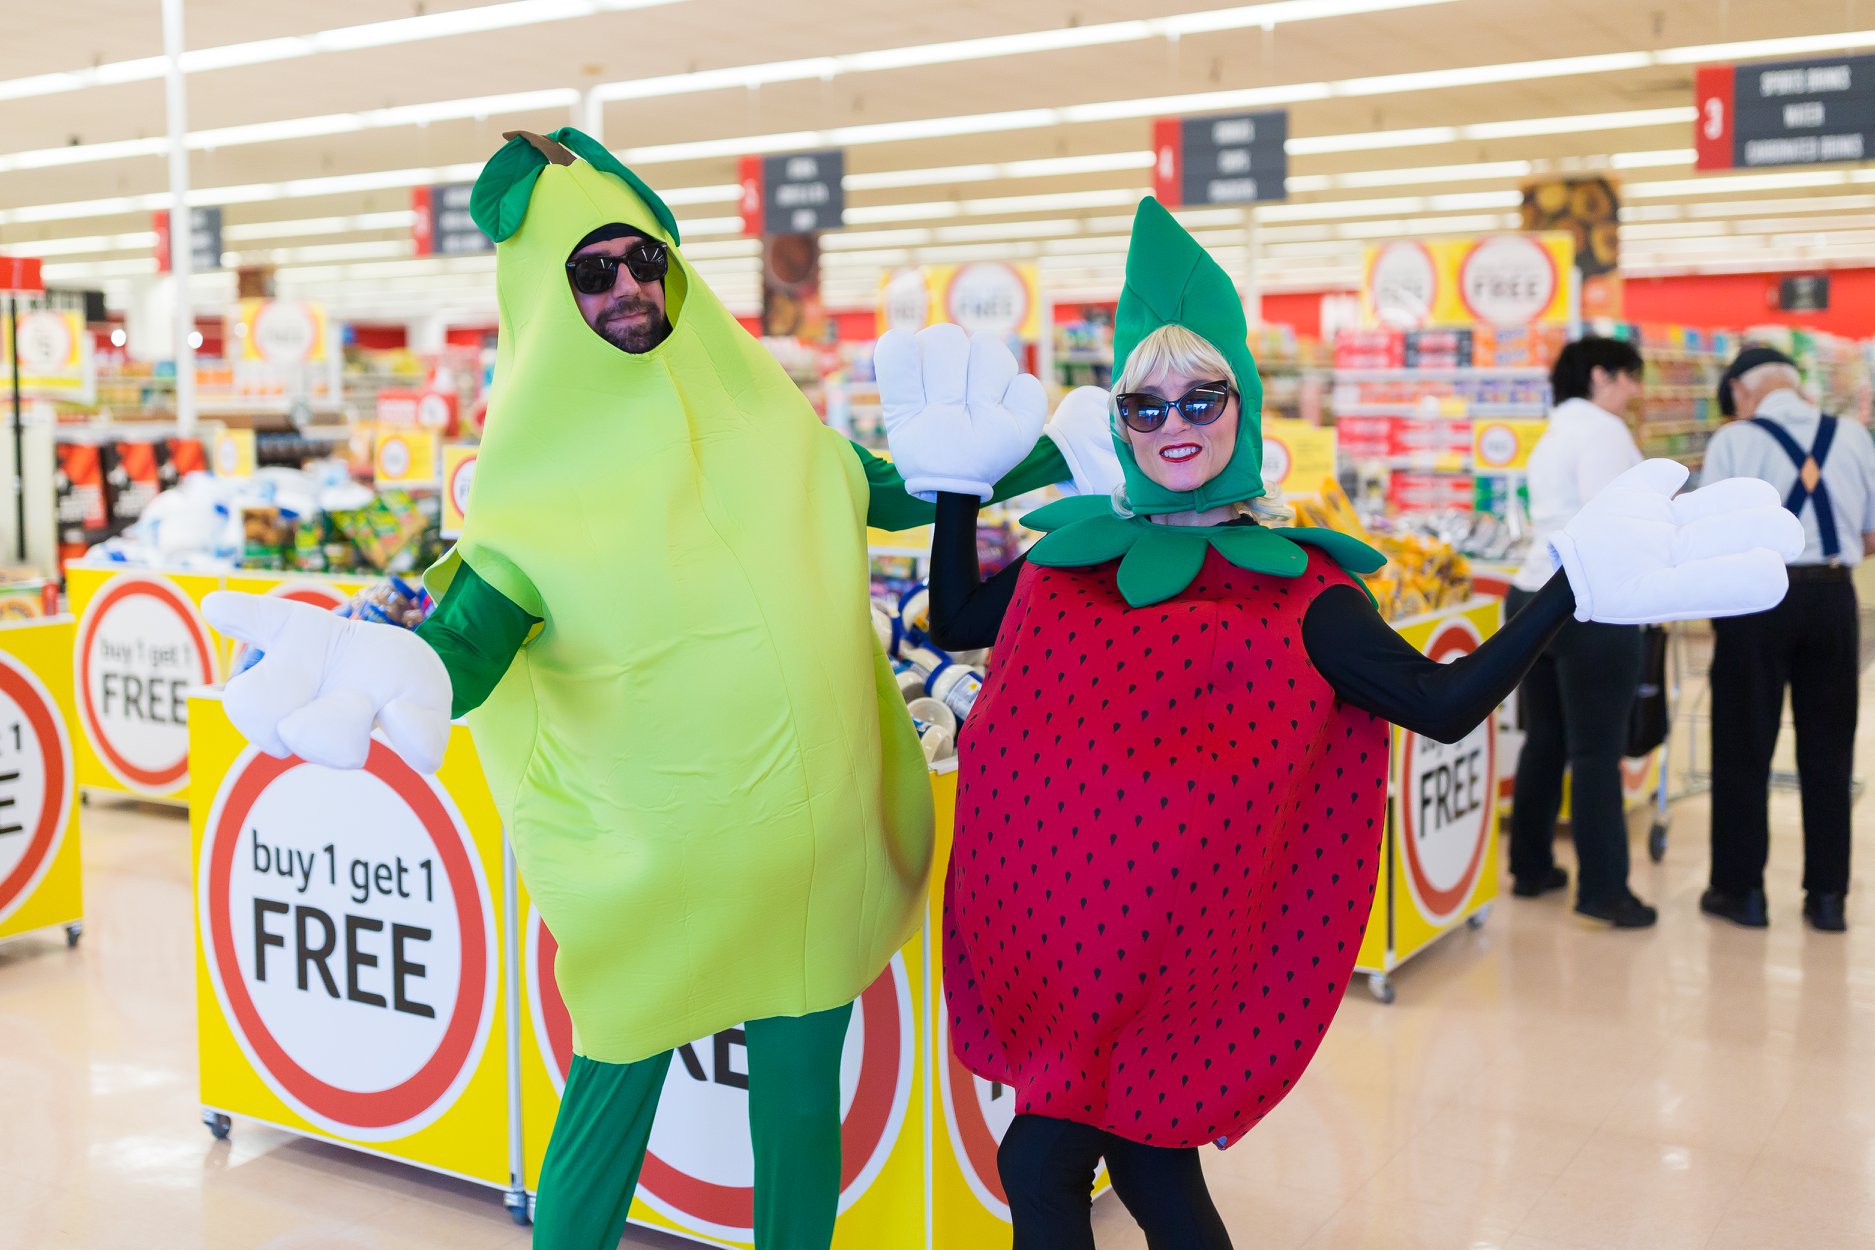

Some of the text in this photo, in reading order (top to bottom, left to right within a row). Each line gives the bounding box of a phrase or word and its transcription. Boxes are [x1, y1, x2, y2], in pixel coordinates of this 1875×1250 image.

[1704, 97, 1723, 140] 3
[102, 672, 187, 726] FREE
[1420, 749, 1481, 838] FREE
[253, 829, 432, 904] buy 1 get 1
[253, 896, 436, 1019] FREE
